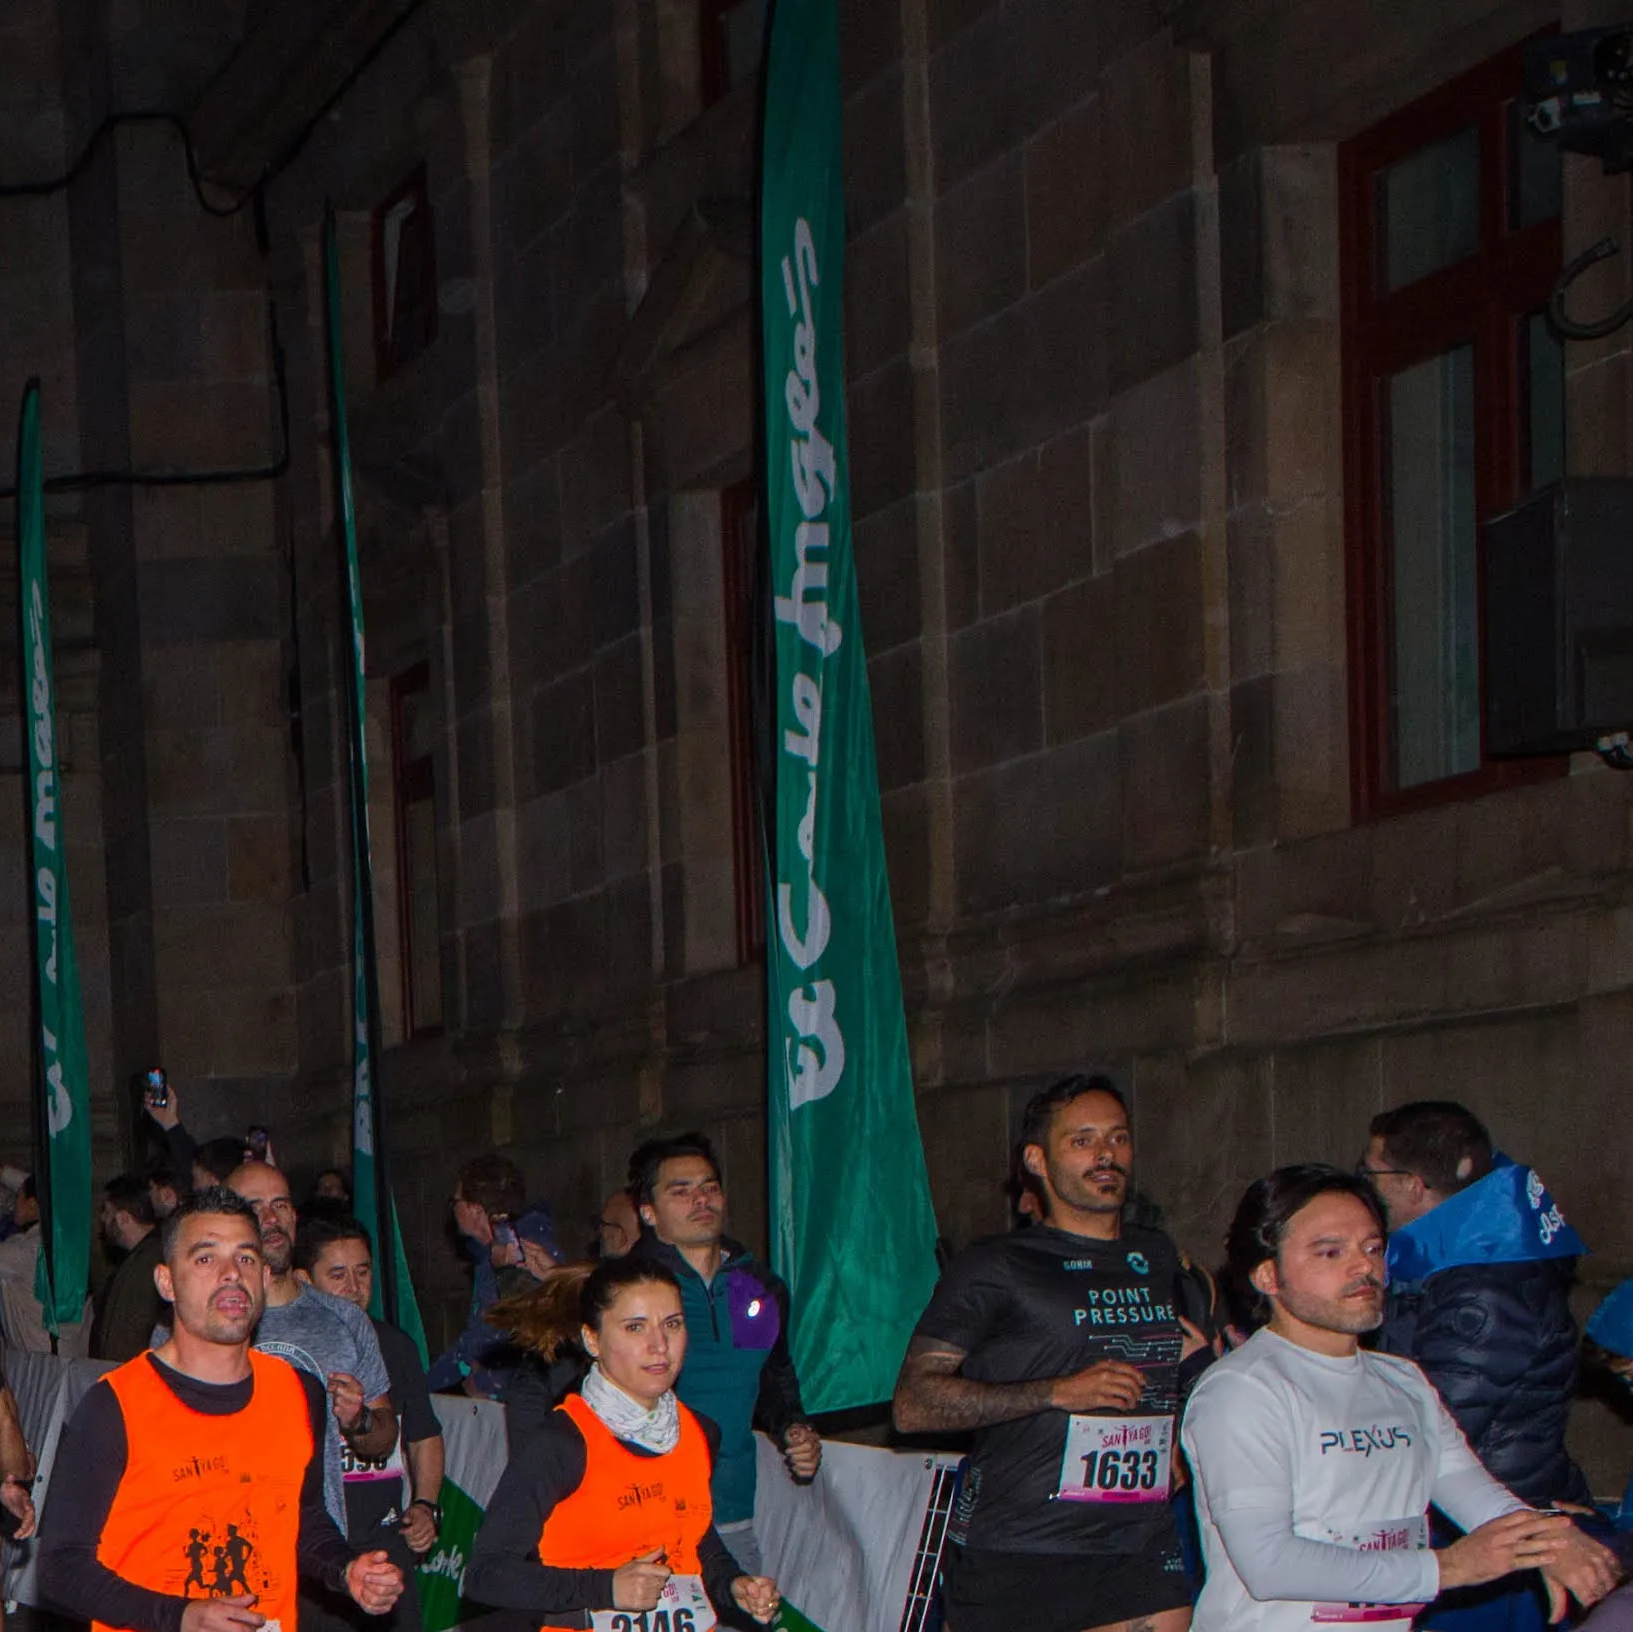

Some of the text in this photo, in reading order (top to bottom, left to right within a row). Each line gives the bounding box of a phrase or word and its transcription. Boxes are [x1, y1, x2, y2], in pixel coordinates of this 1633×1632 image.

[771, 217, 843, 656] Inglés
[1088, 1287, 1153, 1306] POINT
[1074, 1303, 1178, 1327] PRESSURE
[1319, 1426, 1413, 1459] PLEXUS
[1080, 1449, 1158, 1492] 1633
